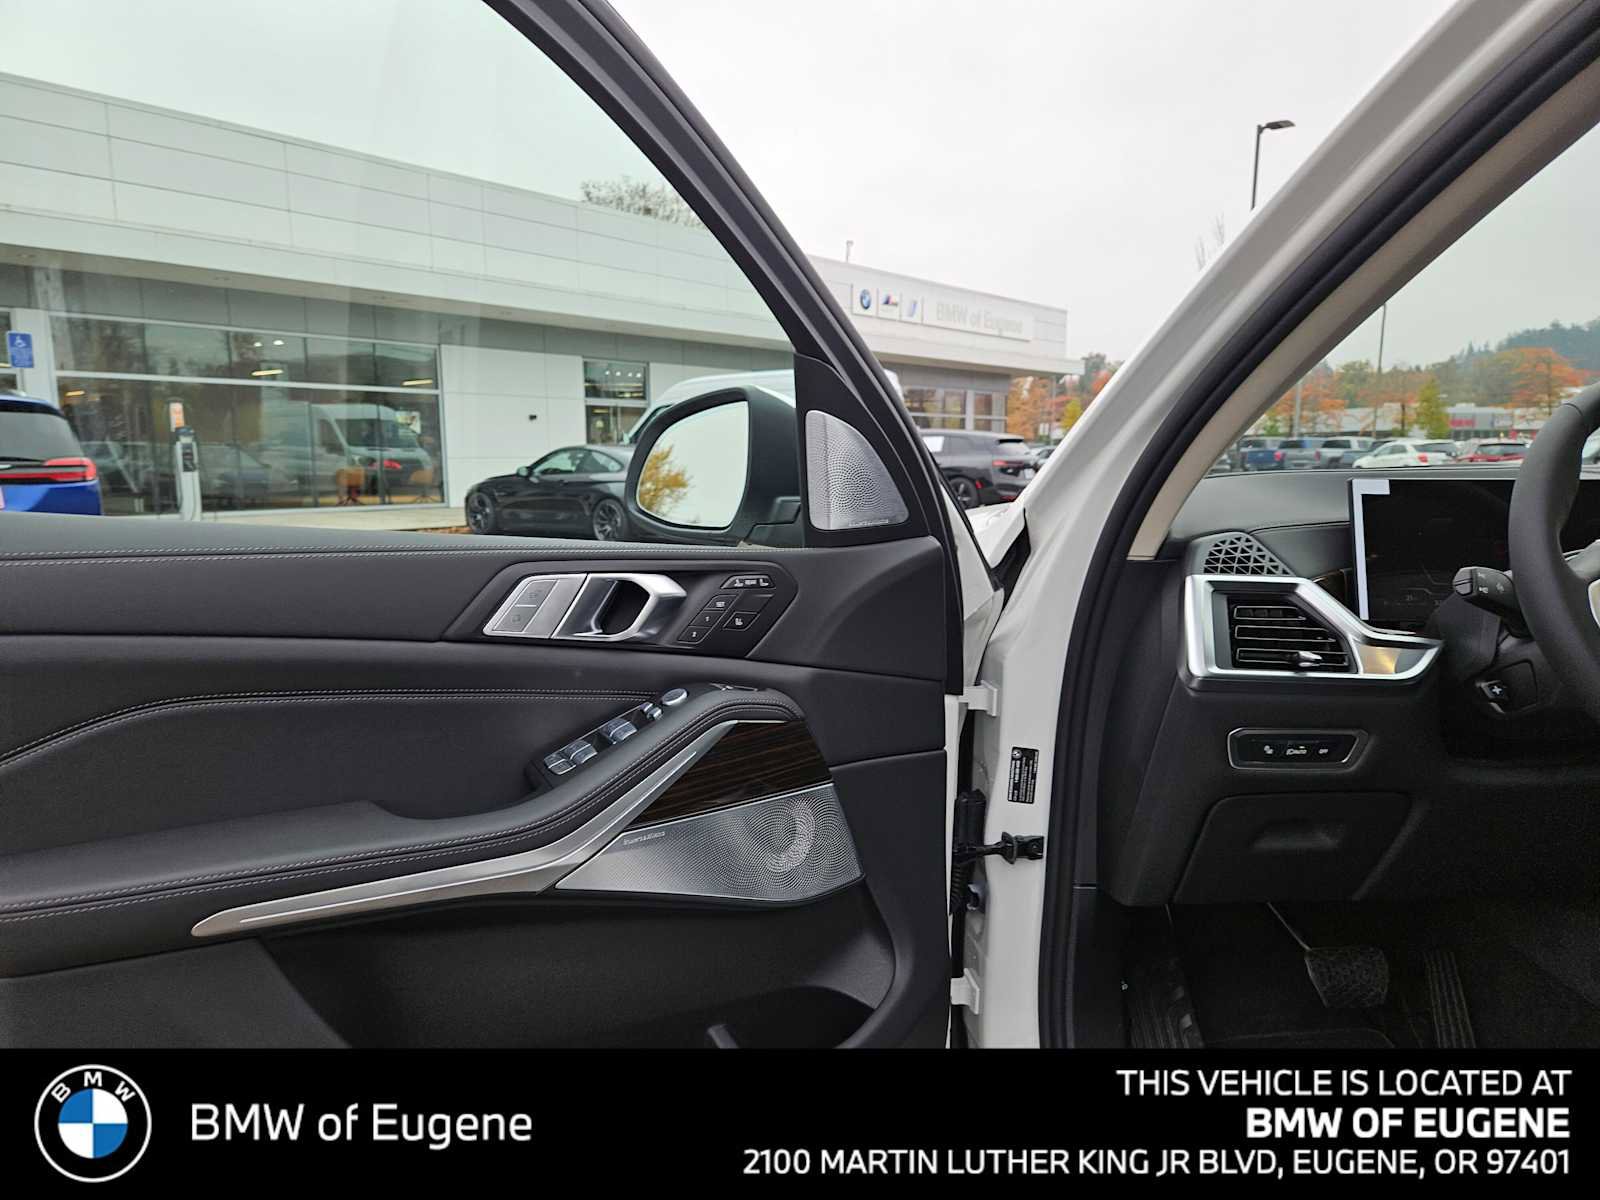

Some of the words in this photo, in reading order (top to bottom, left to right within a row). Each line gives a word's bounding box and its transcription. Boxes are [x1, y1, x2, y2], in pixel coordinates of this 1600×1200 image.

[936, 303, 968, 326] BMW
[969, 307, 981, 328] of
[983, 308, 1023, 335] Eugene
